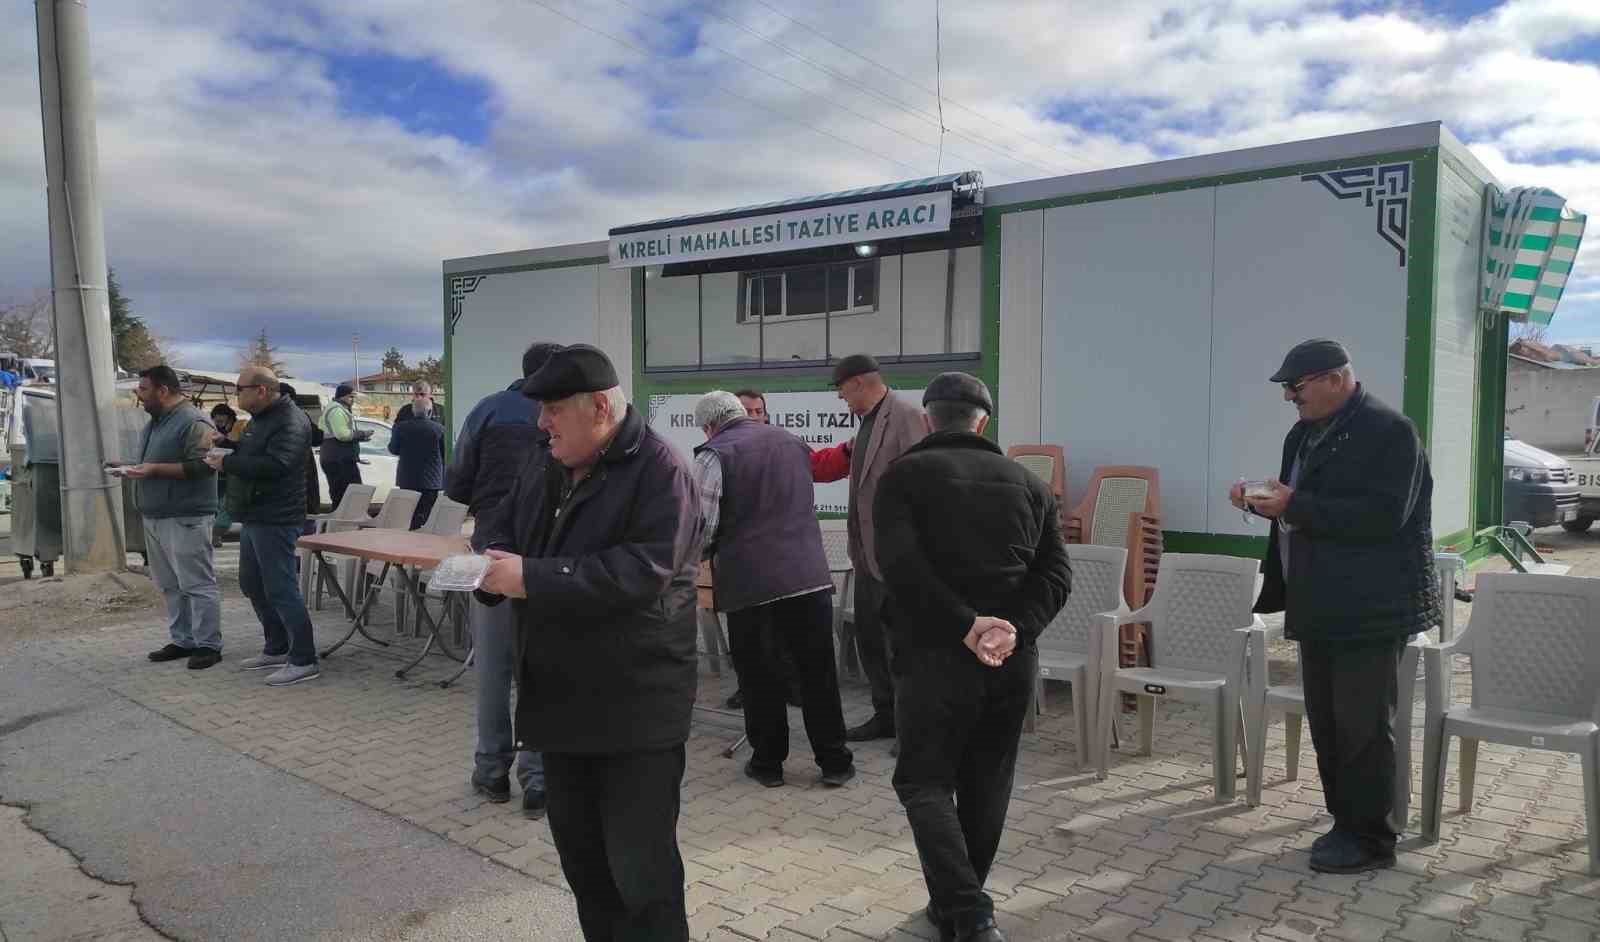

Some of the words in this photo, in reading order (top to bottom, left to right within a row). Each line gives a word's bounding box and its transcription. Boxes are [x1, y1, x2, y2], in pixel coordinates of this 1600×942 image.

[618, 234, 671, 259] KIRELİ
[680, 220, 781, 253] MAHALLESİ
[787, 213, 859, 241] TAZİYE
[866, 204, 935, 230] ARACI
[670, 414, 704, 427] KIR
[767, 410, 810, 428] LLESİ
[800, 433, 833, 443] ALLESİ
